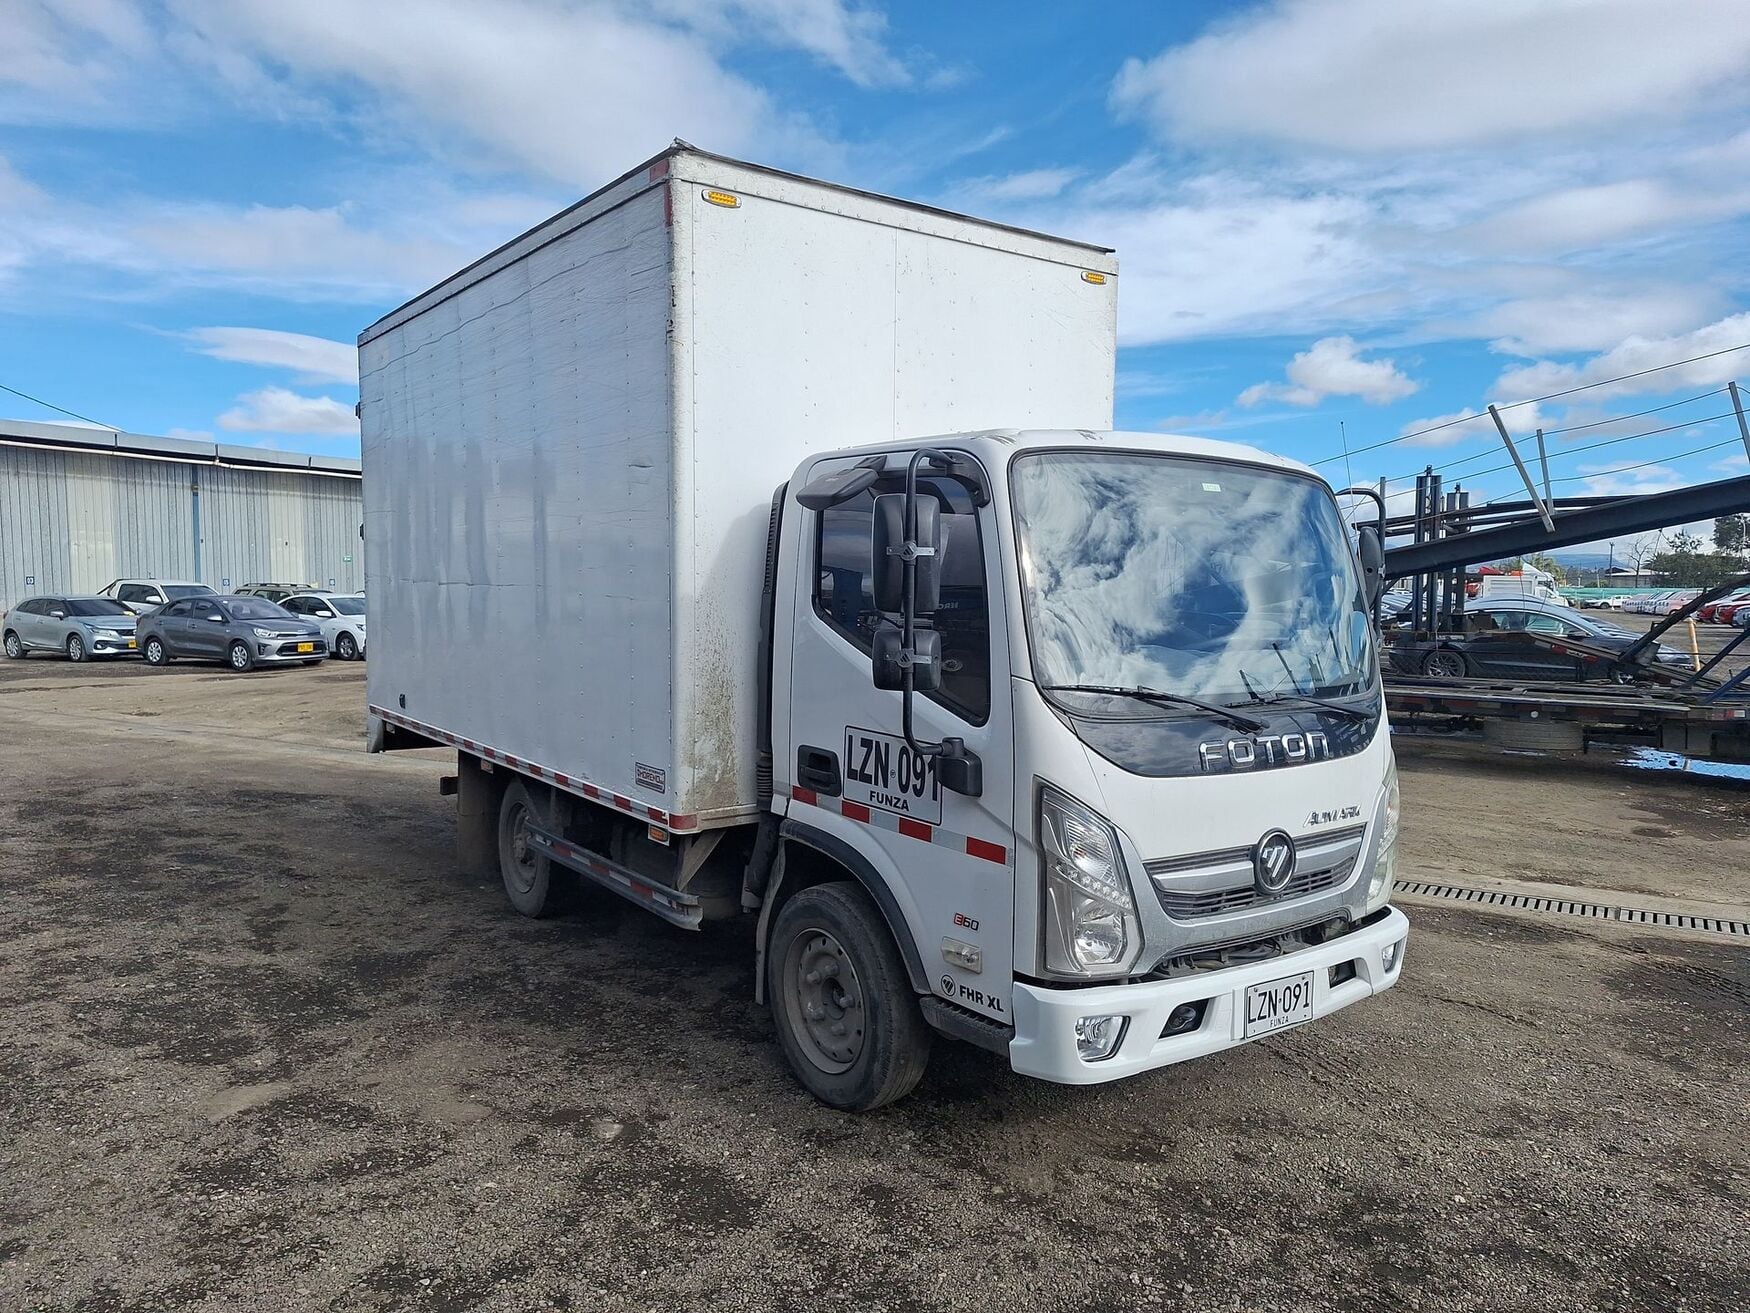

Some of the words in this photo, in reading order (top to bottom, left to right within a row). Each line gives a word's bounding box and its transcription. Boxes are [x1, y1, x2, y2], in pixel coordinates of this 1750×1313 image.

[847, 734, 889, 789] LZN
[1199, 731, 1330, 771] FOTON
[869, 790, 909, 812] FUNZA
[959, 984, 984, 1006] FHR
[987, 994, 1004, 1012] XL
[1247, 988, 1278, 1024] LZN
[1282, 980, 1310, 1014] 091
[1270, 1015, 1289, 1028] FUNZA
